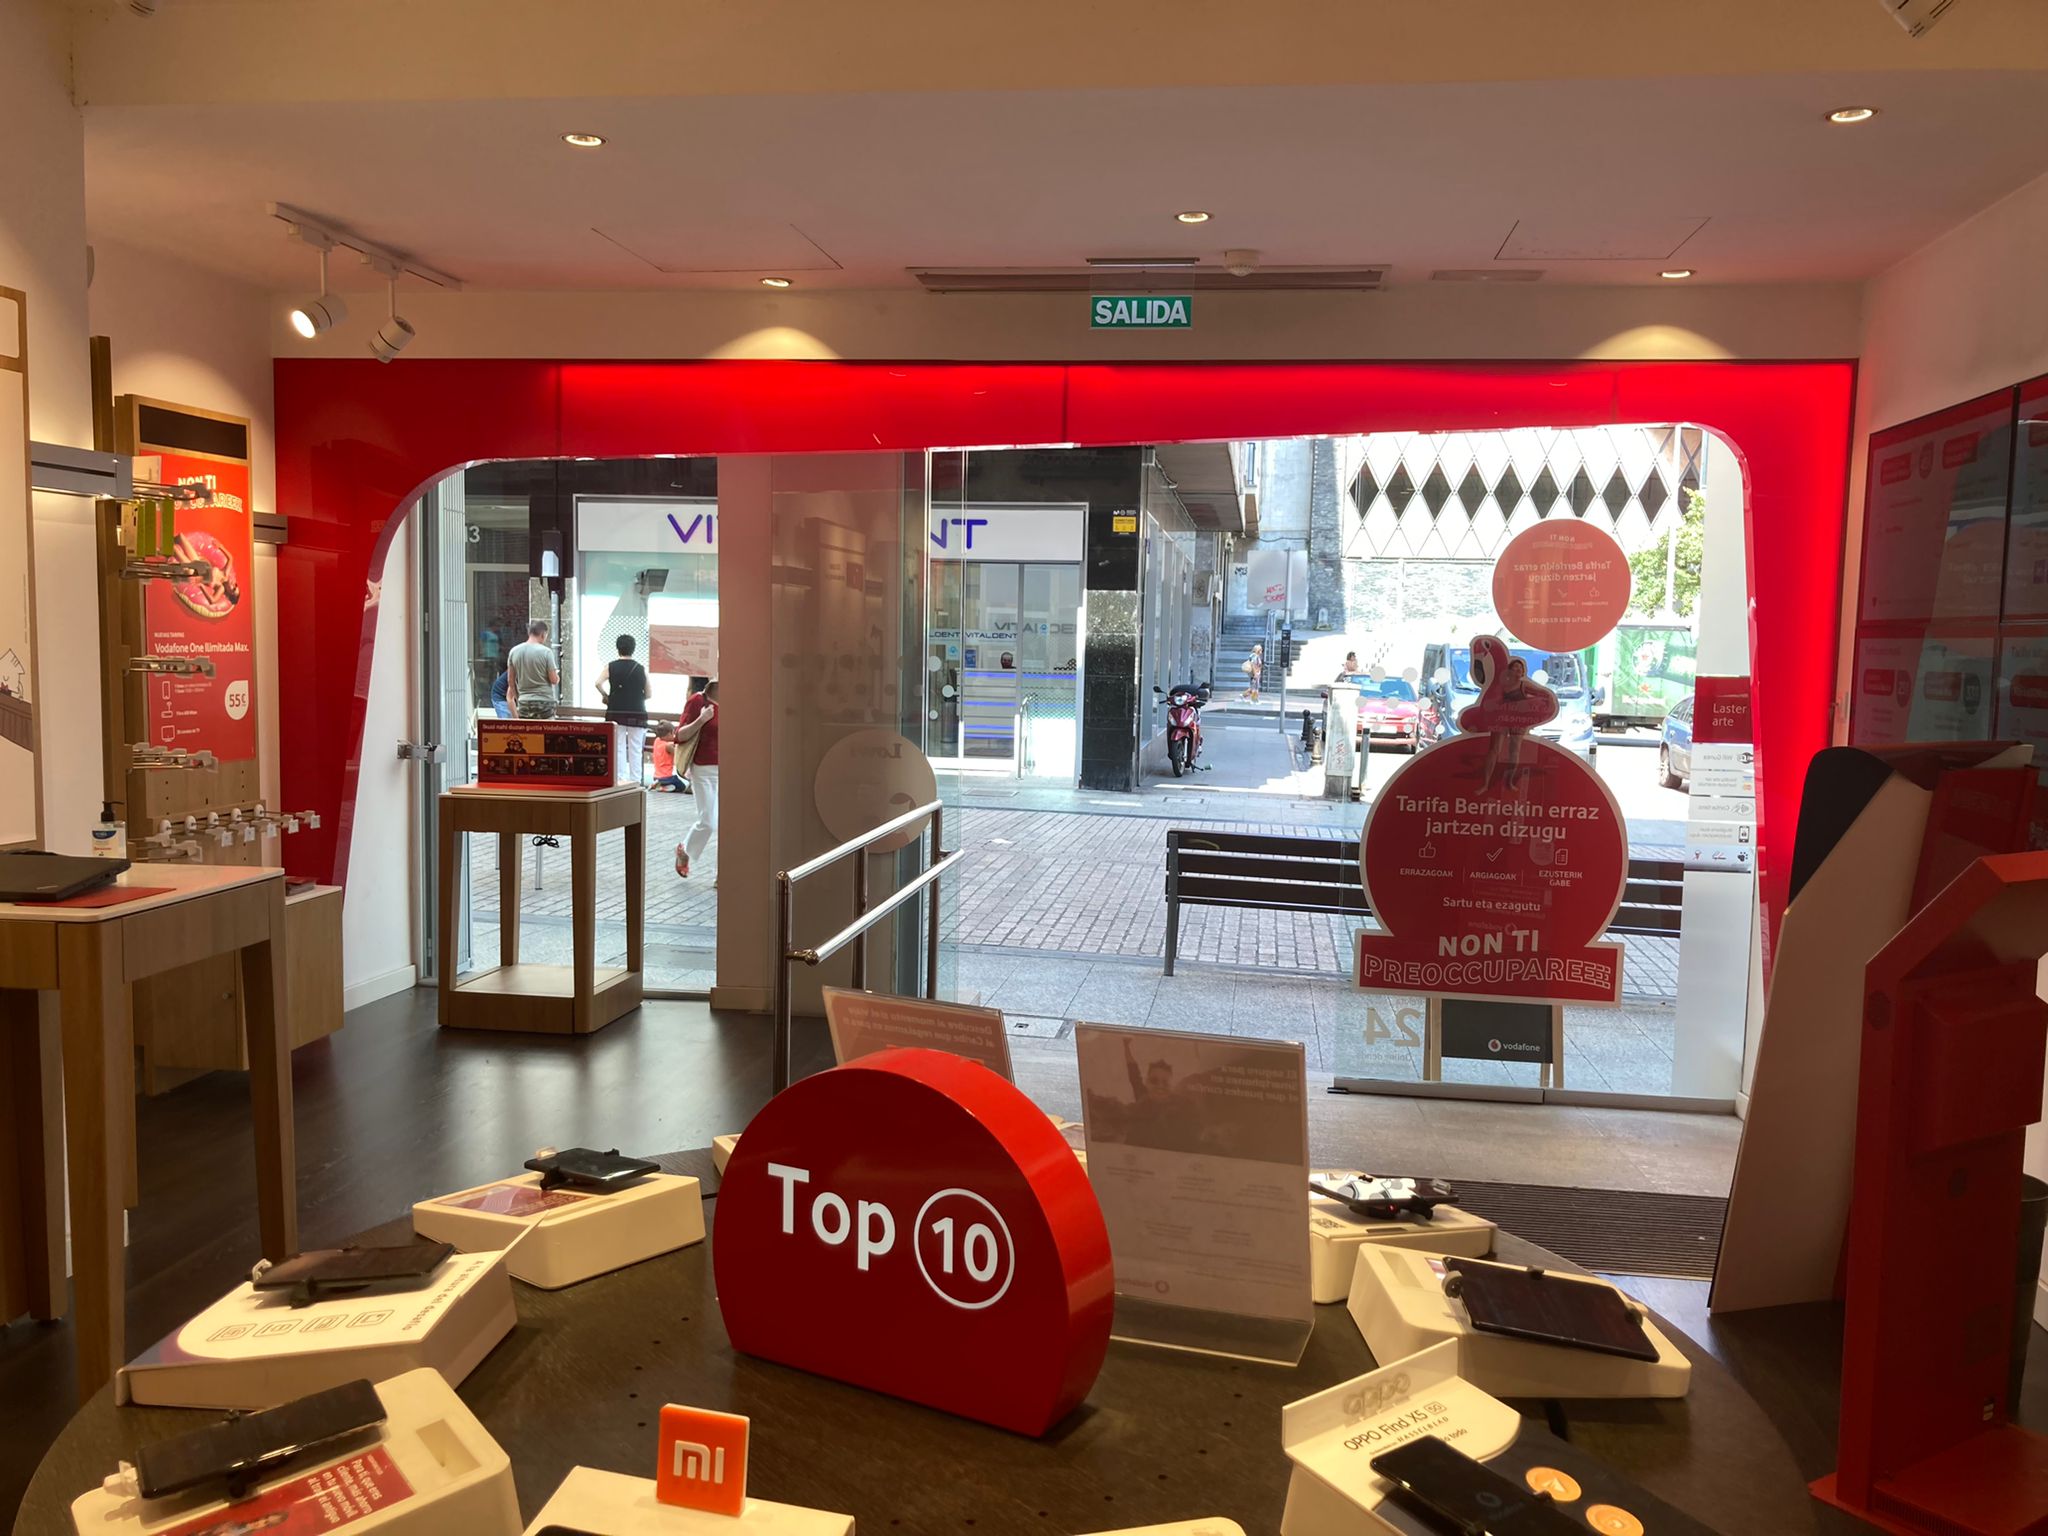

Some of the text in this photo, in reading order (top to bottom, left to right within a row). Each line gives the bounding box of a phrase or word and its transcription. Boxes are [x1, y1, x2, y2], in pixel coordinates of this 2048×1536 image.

[1094, 300, 1187, 324] SALIDA
[205, 475, 216, 490] TI
[155, 643, 189, 653] Vodafone
[190, 643, 204, 653] One
[205, 642, 234, 653] Ilimitada
[1712, 703, 1747, 727] Laster arte
[1396, 795, 1599, 820] Tarifa Berriekin erraz
[1425, 817, 1566, 843] jartzen dizugu
[1400, 868, 1453, 878] ERRAZAGOAK
[1469, 871, 1517, 881] ARGIAGOAK
[1538, 869, 1583, 879] EZUSTERIK
[1549, 879, 1571, 887] GABE
[1443, 896, 1541, 913] Sartu eta ezagutu
[1438, 929, 1539, 957] NON TI
[1503, 1042, 1541, 1053] vodafone
[768, 1162, 998, 1282] Top 10
[1344, 1430, 1381, 1451] OPPO
[1379, 1417, 1411, 1437] Find
[1408, 1409, 1429, 1424] X5
[1396, 1416, 1449, 1443] HASSELBLAD
